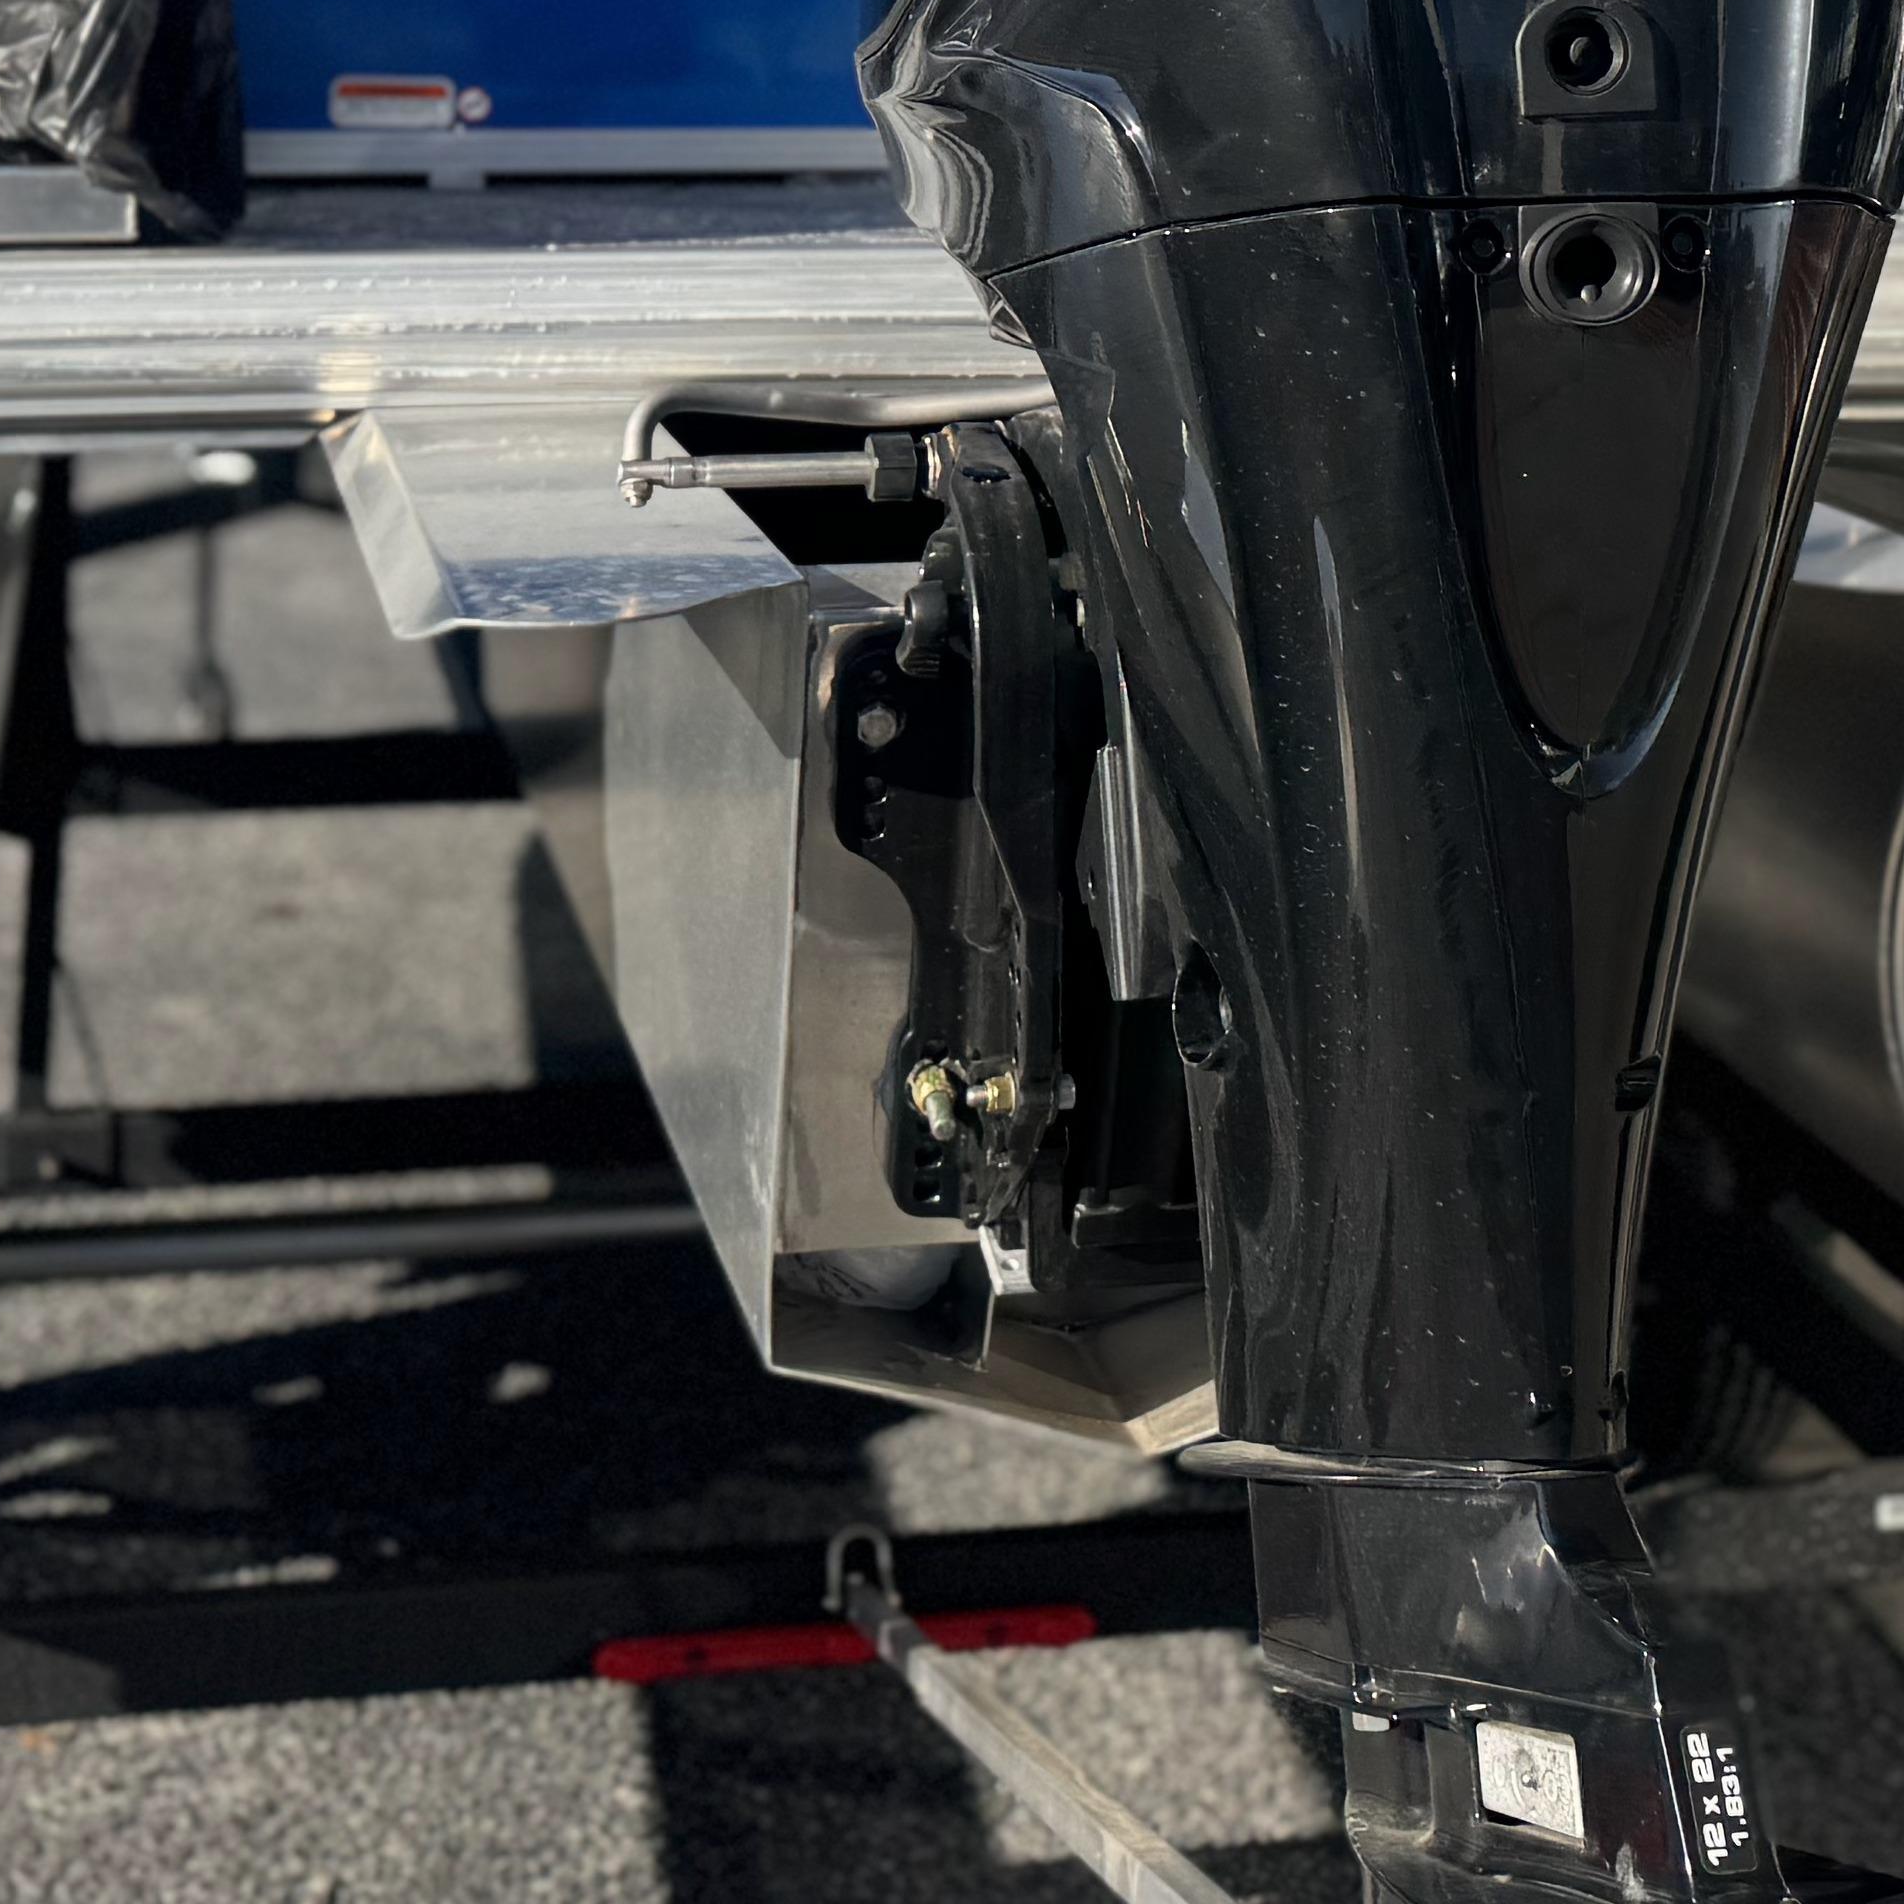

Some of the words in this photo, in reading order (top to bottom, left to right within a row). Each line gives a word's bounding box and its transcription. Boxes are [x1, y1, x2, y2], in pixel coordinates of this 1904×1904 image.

[1686, 1732, 1716, 1784] 22
[1715, 1747, 1750, 1847] 1.83:1
[1702, 1821, 1728, 1867] 12
